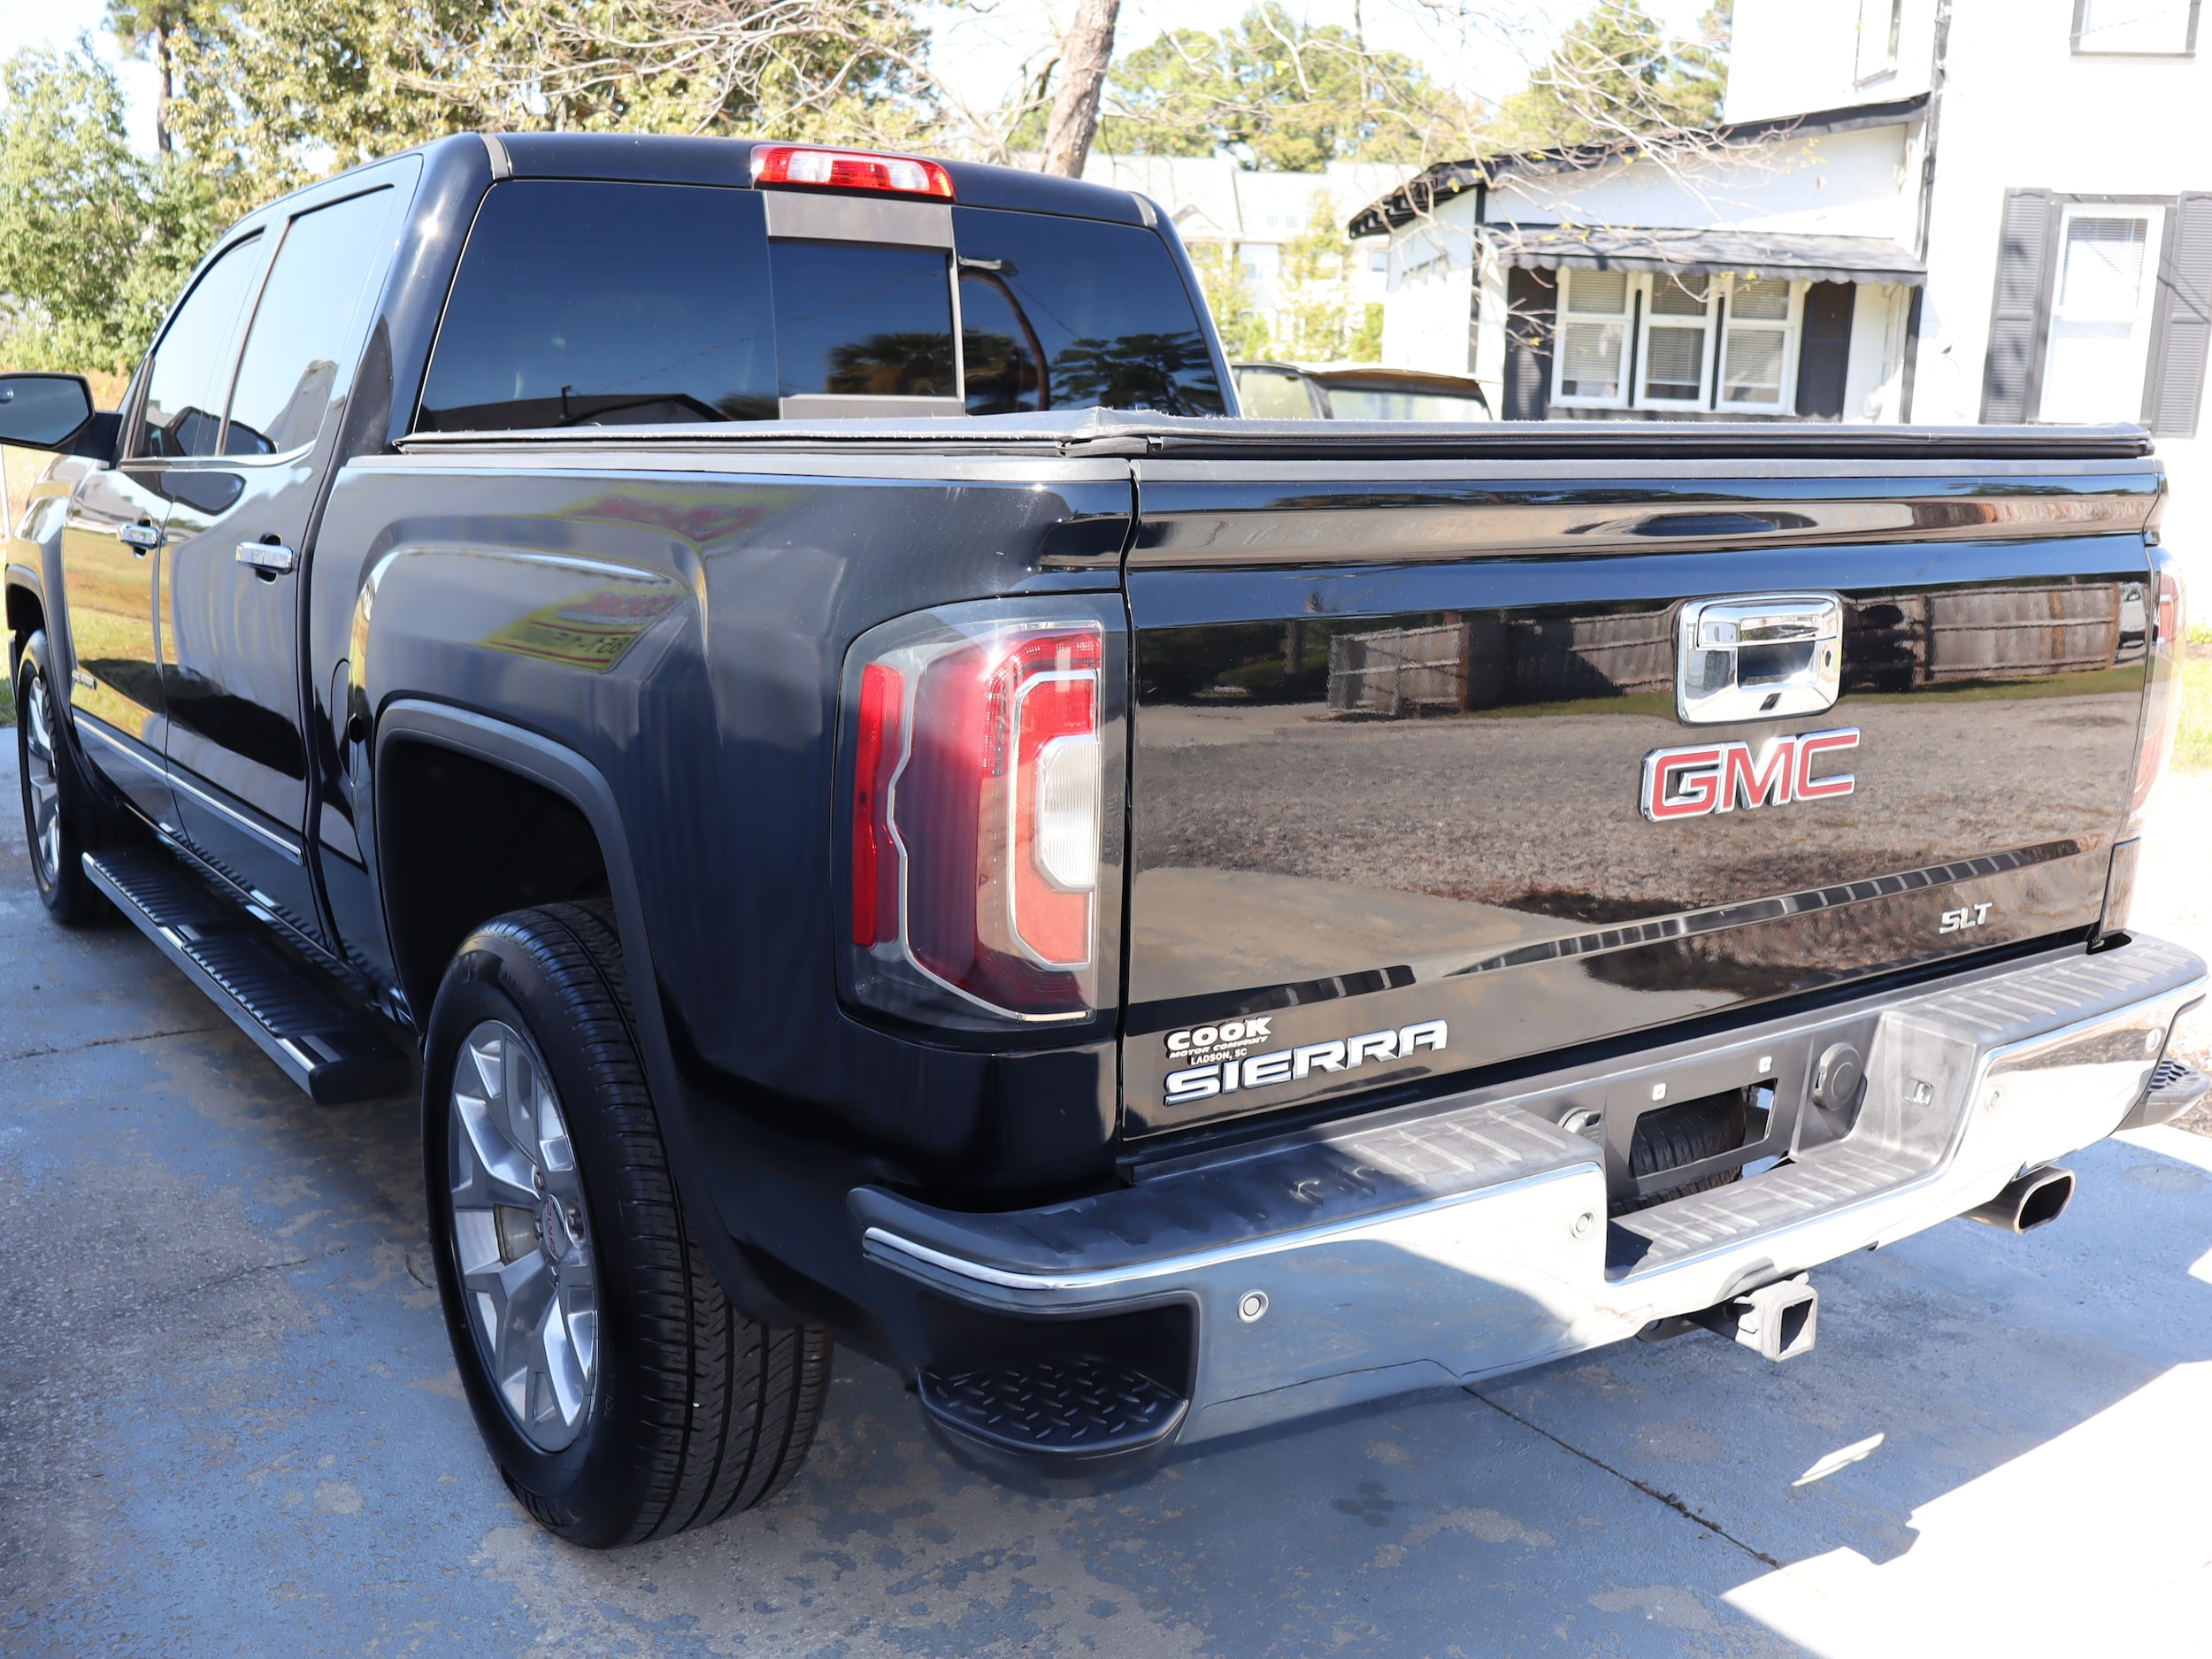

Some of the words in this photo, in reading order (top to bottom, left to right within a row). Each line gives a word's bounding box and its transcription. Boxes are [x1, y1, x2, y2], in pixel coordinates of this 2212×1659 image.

[1640, 727, 1860, 822] GMC
[1939, 902, 1993, 934] SLT
[1165, 1017, 1272, 1051] COOK
[1168, 1046, 1211, 1059] MOTOR
[1212, 1035, 1269, 1051] COMPANY
[1164, 1019, 1448, 1106] SIERRA
[1189, 1050, 1233, 1066] LADSON,
[1234, 1048, 1248, 1057] SC
